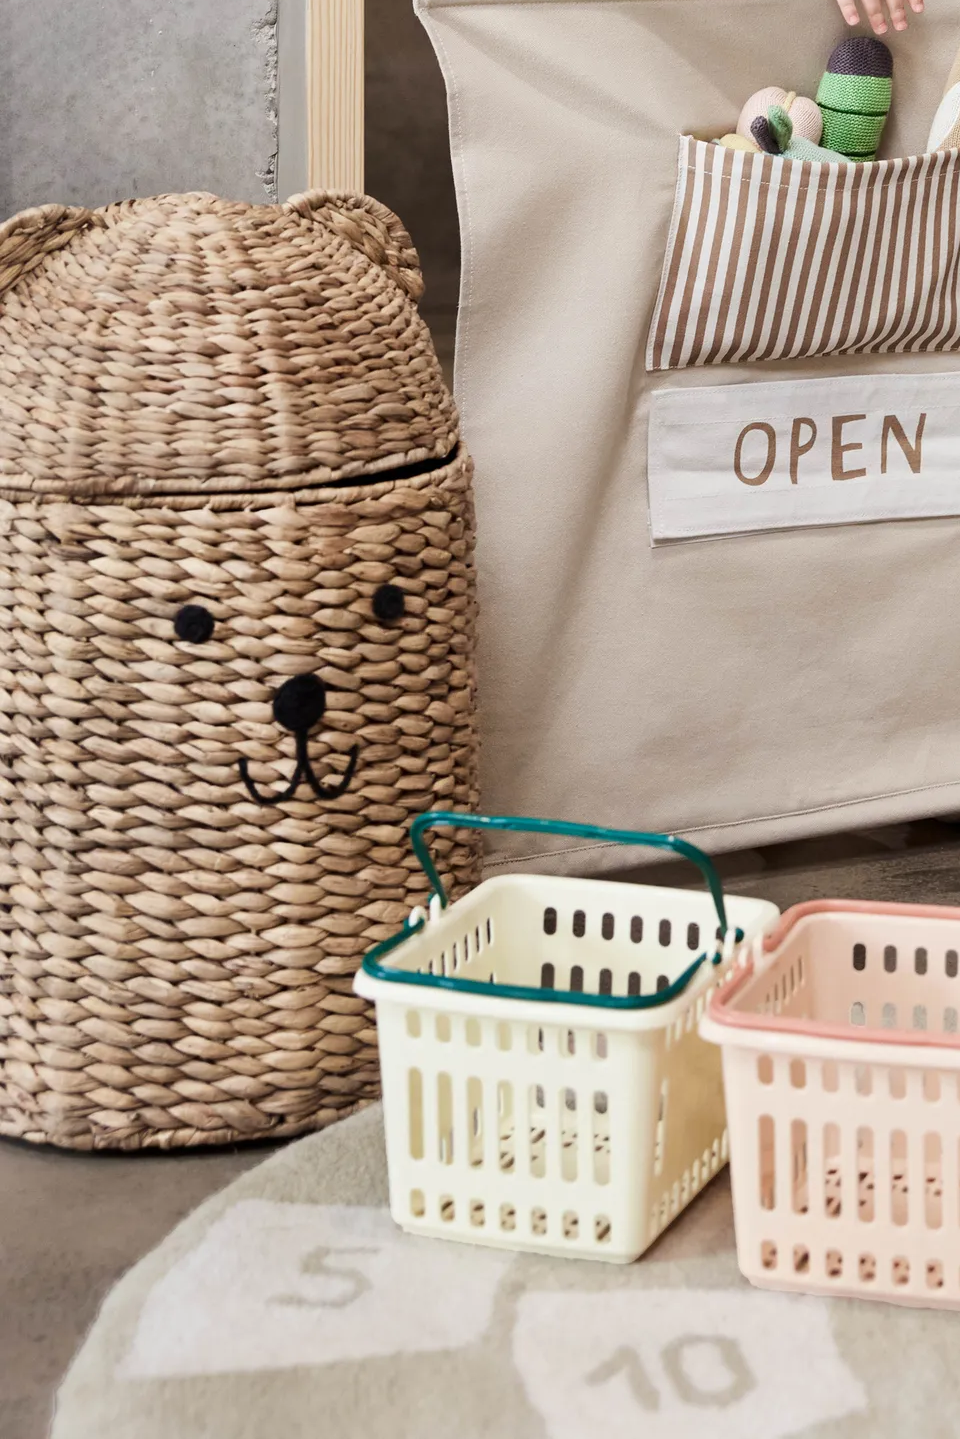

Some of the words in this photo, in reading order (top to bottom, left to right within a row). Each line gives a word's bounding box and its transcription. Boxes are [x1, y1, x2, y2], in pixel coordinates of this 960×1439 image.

[733, 412, 927, 487] OPEN
[265, 1245, 381, 1308] 5
[584, 1333, 759, 1413] 10
